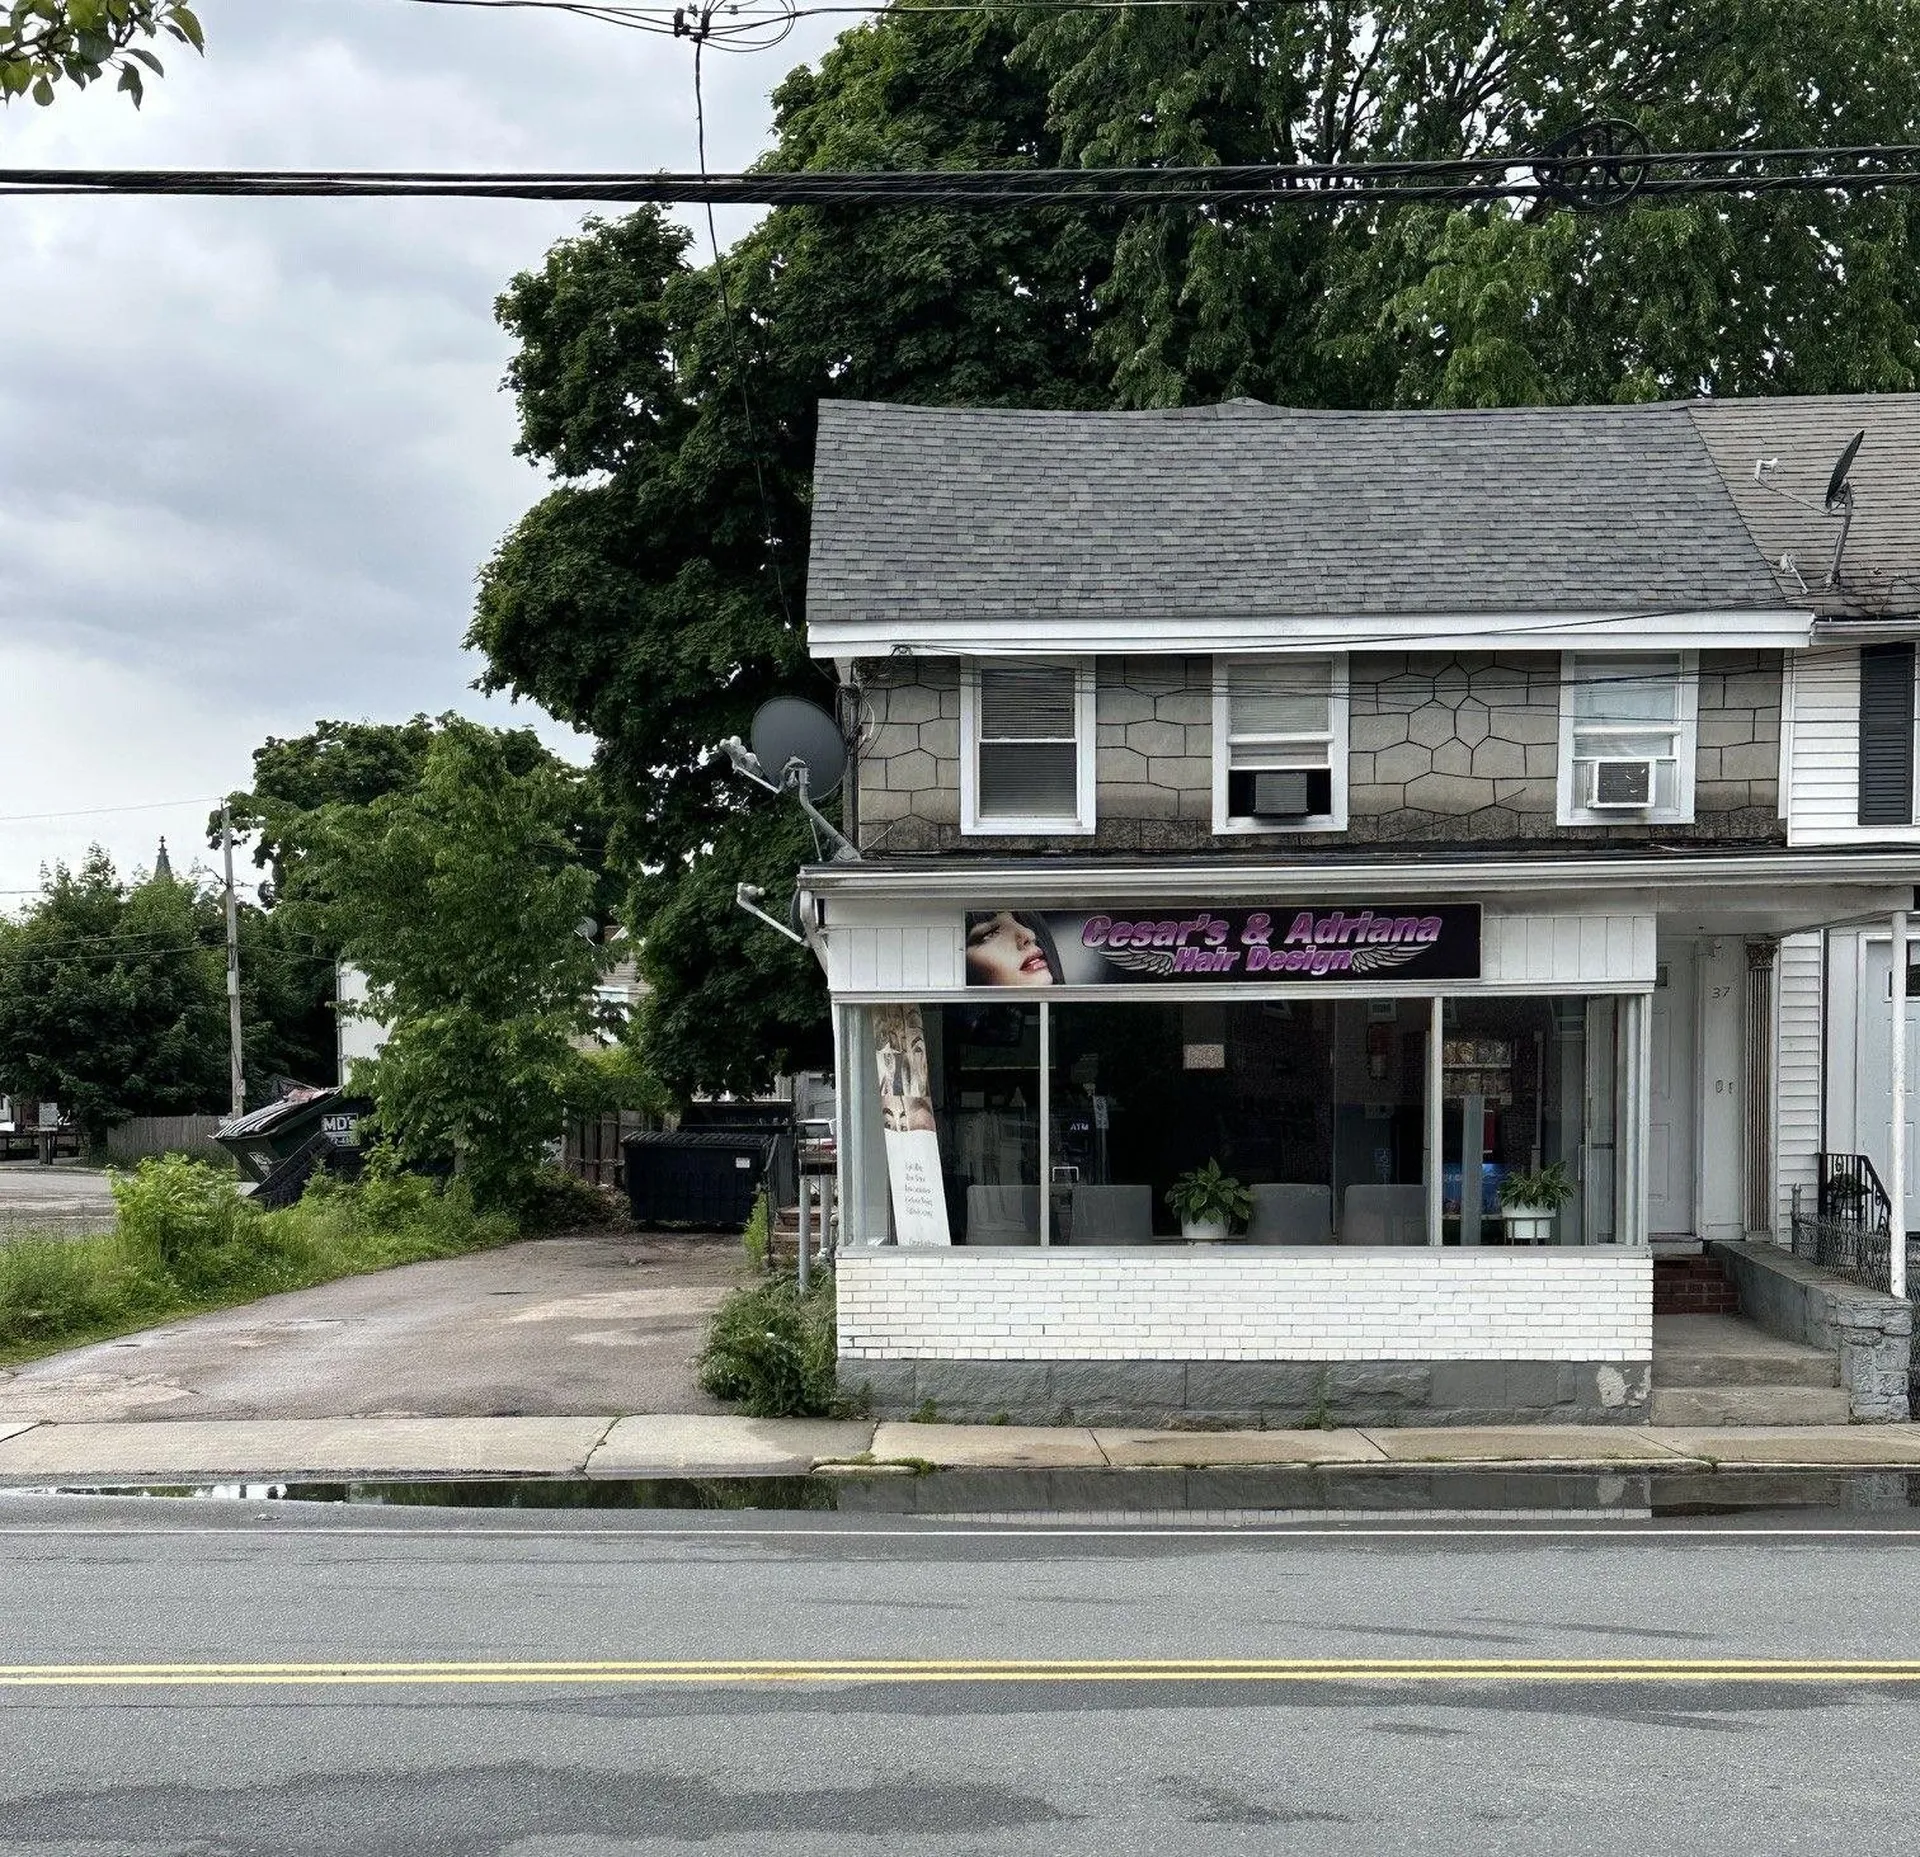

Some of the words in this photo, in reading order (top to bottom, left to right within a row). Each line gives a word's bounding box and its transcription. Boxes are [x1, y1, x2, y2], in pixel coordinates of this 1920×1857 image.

[1082, 914, 1230, 948] Cesar's
[1241, 912, 1274, 946] &
[1284, 911, 1443, 944] Adriana
[1173, 946, 1241, 972] Hair
[1246, 945, 1351, 976] Design
[1711, 986, 1730, 999] 37
